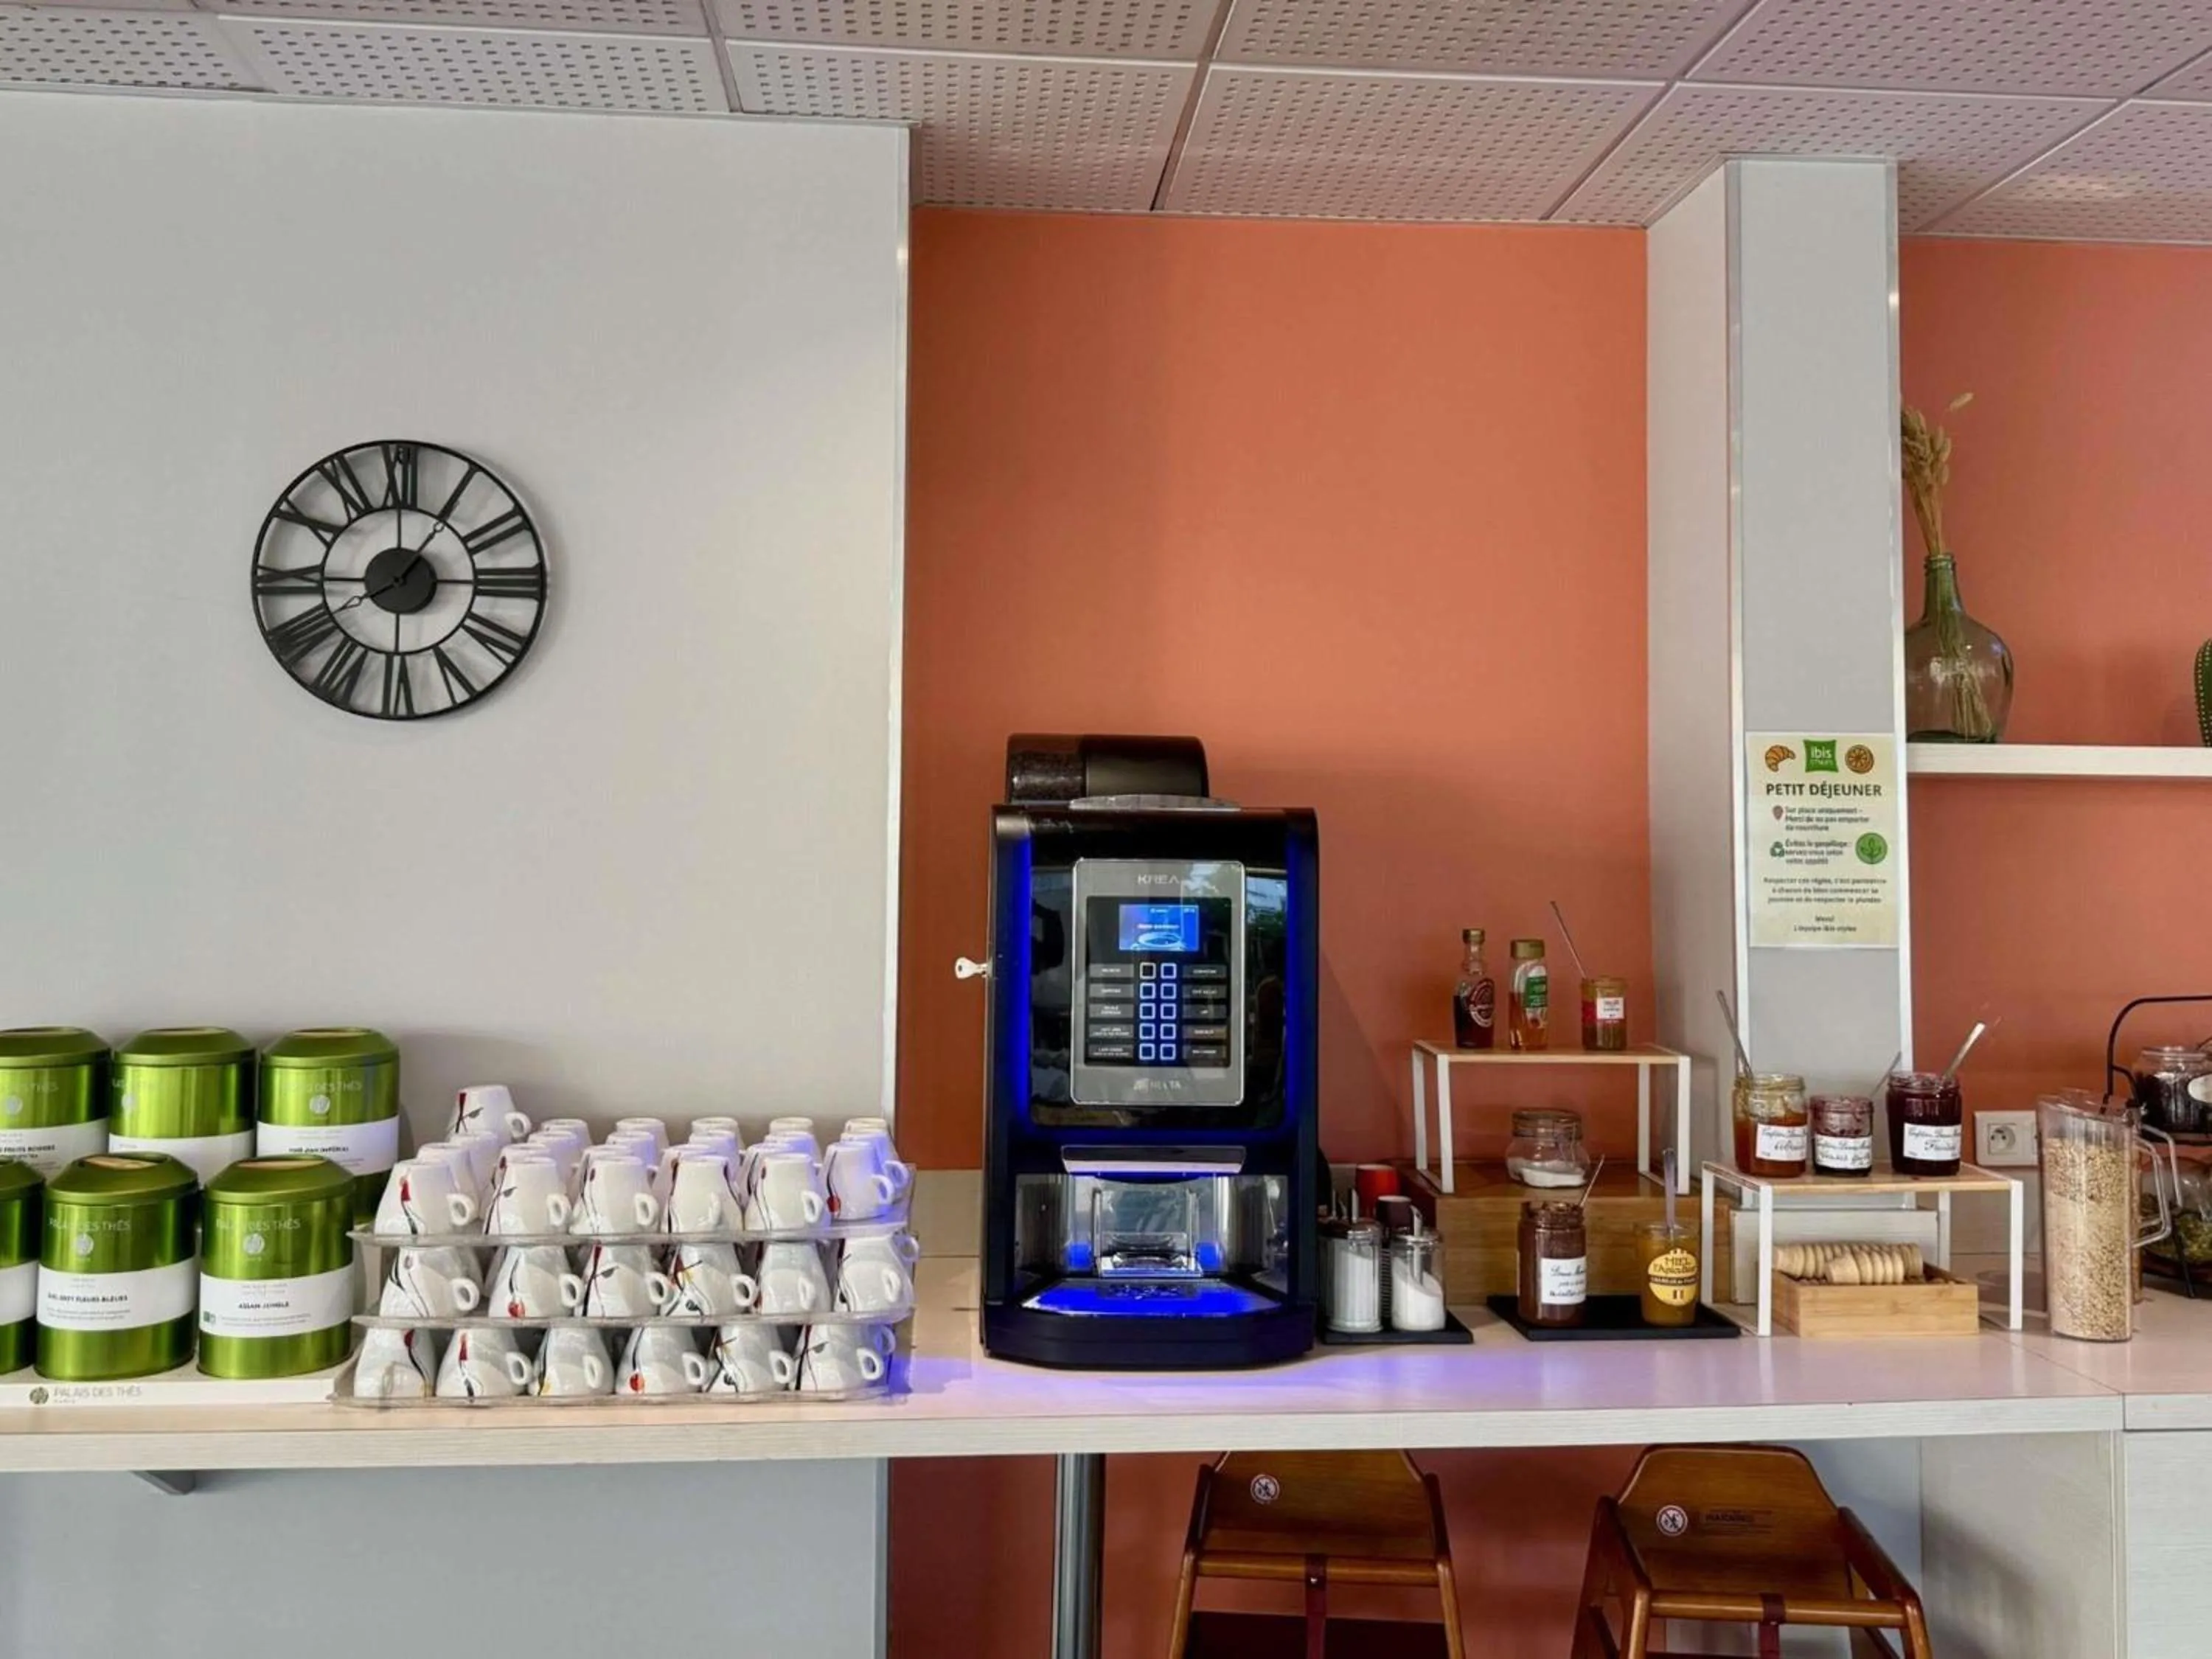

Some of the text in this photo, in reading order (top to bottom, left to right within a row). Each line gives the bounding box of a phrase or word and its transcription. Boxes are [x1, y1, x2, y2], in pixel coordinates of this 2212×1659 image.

[1810, 746, 1832, 758] ibis
[1766, 780, 1882, 799] PETIT DÉJEUNER
